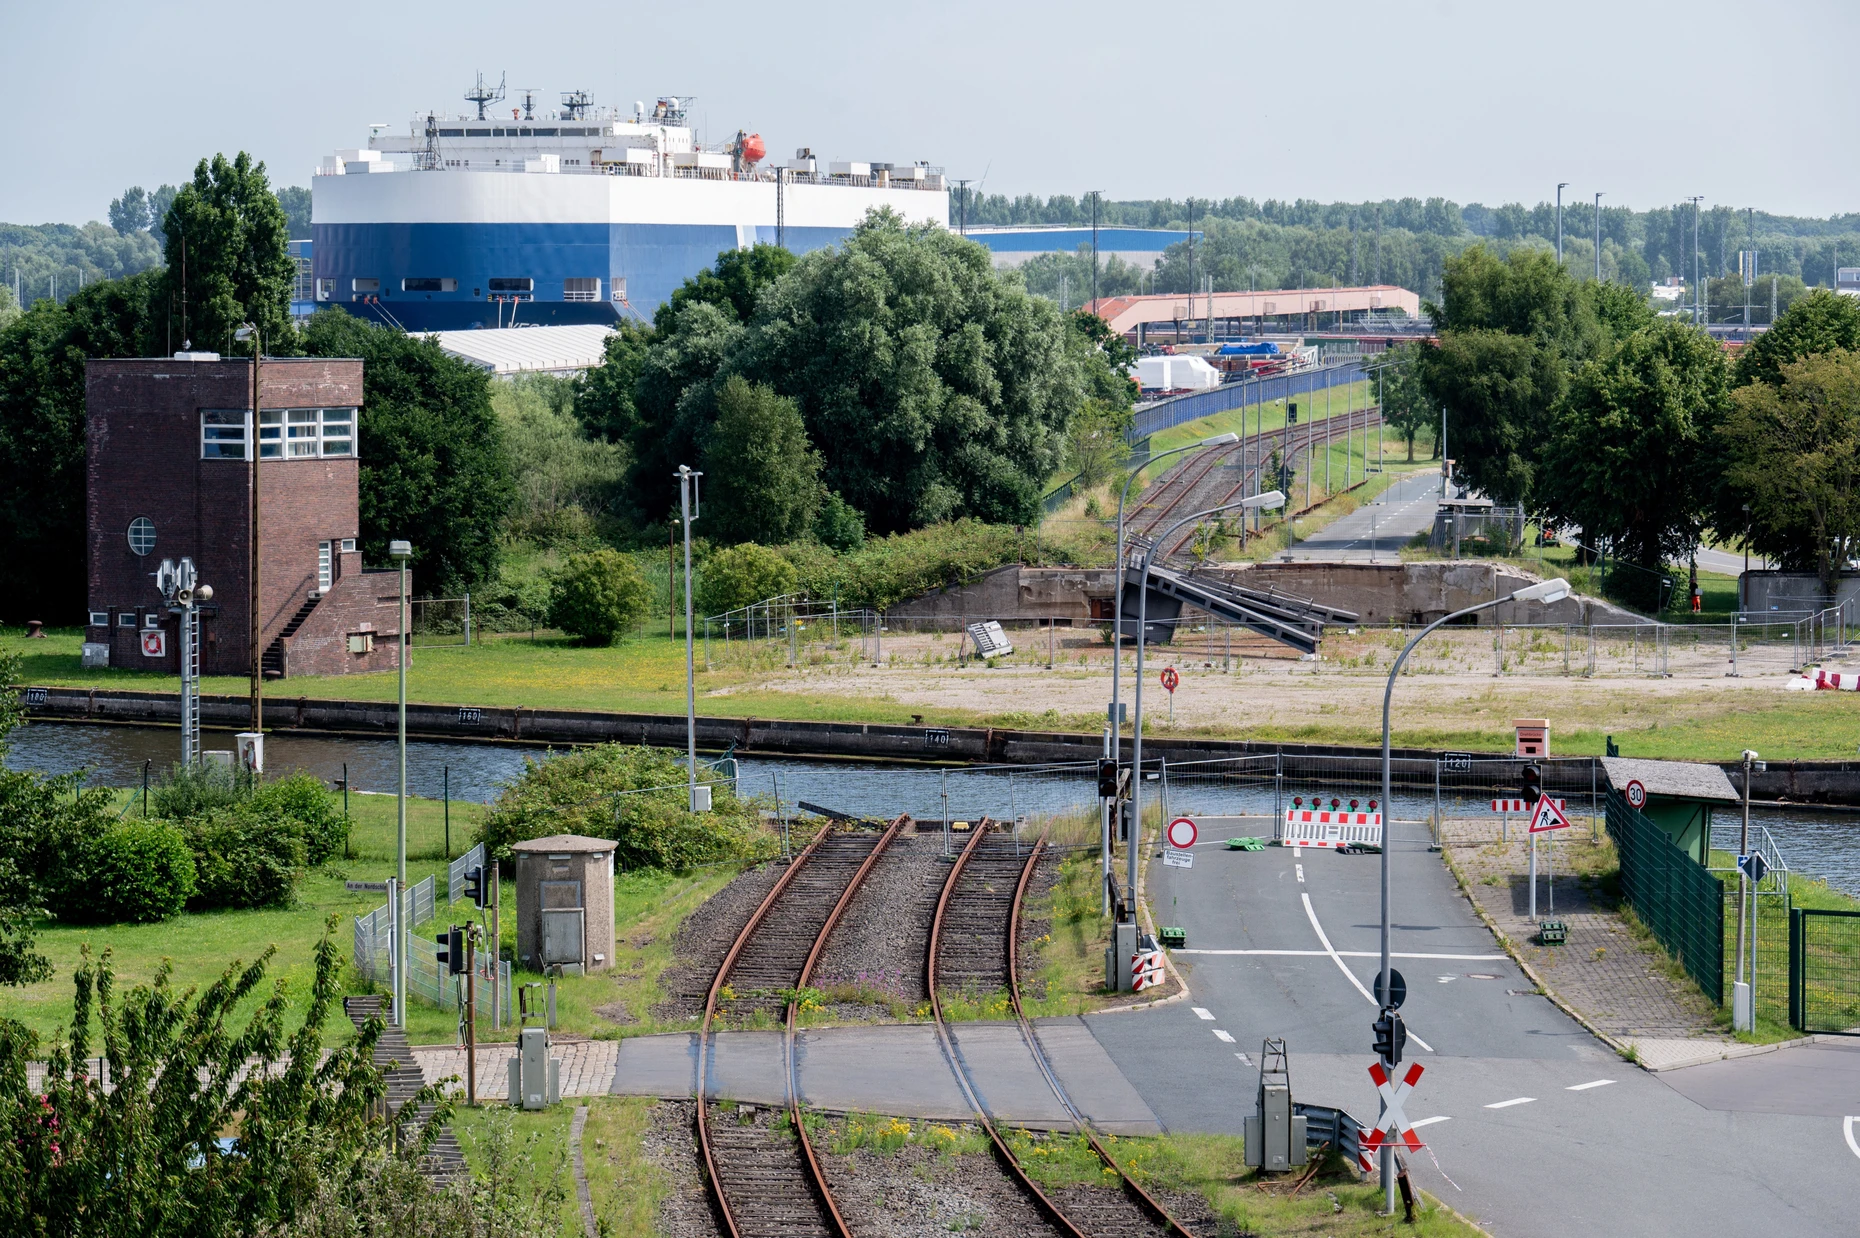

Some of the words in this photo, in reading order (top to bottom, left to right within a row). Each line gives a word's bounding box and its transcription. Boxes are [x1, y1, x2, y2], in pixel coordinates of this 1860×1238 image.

[463, 711, 478, 720] 160
[930, 734, 946, 744] 140
[1450, 758, 1467, 768] 120
[1630, 787, 1642, 801] 30
[1166, 855, 1191, 863] fahrzeuge
